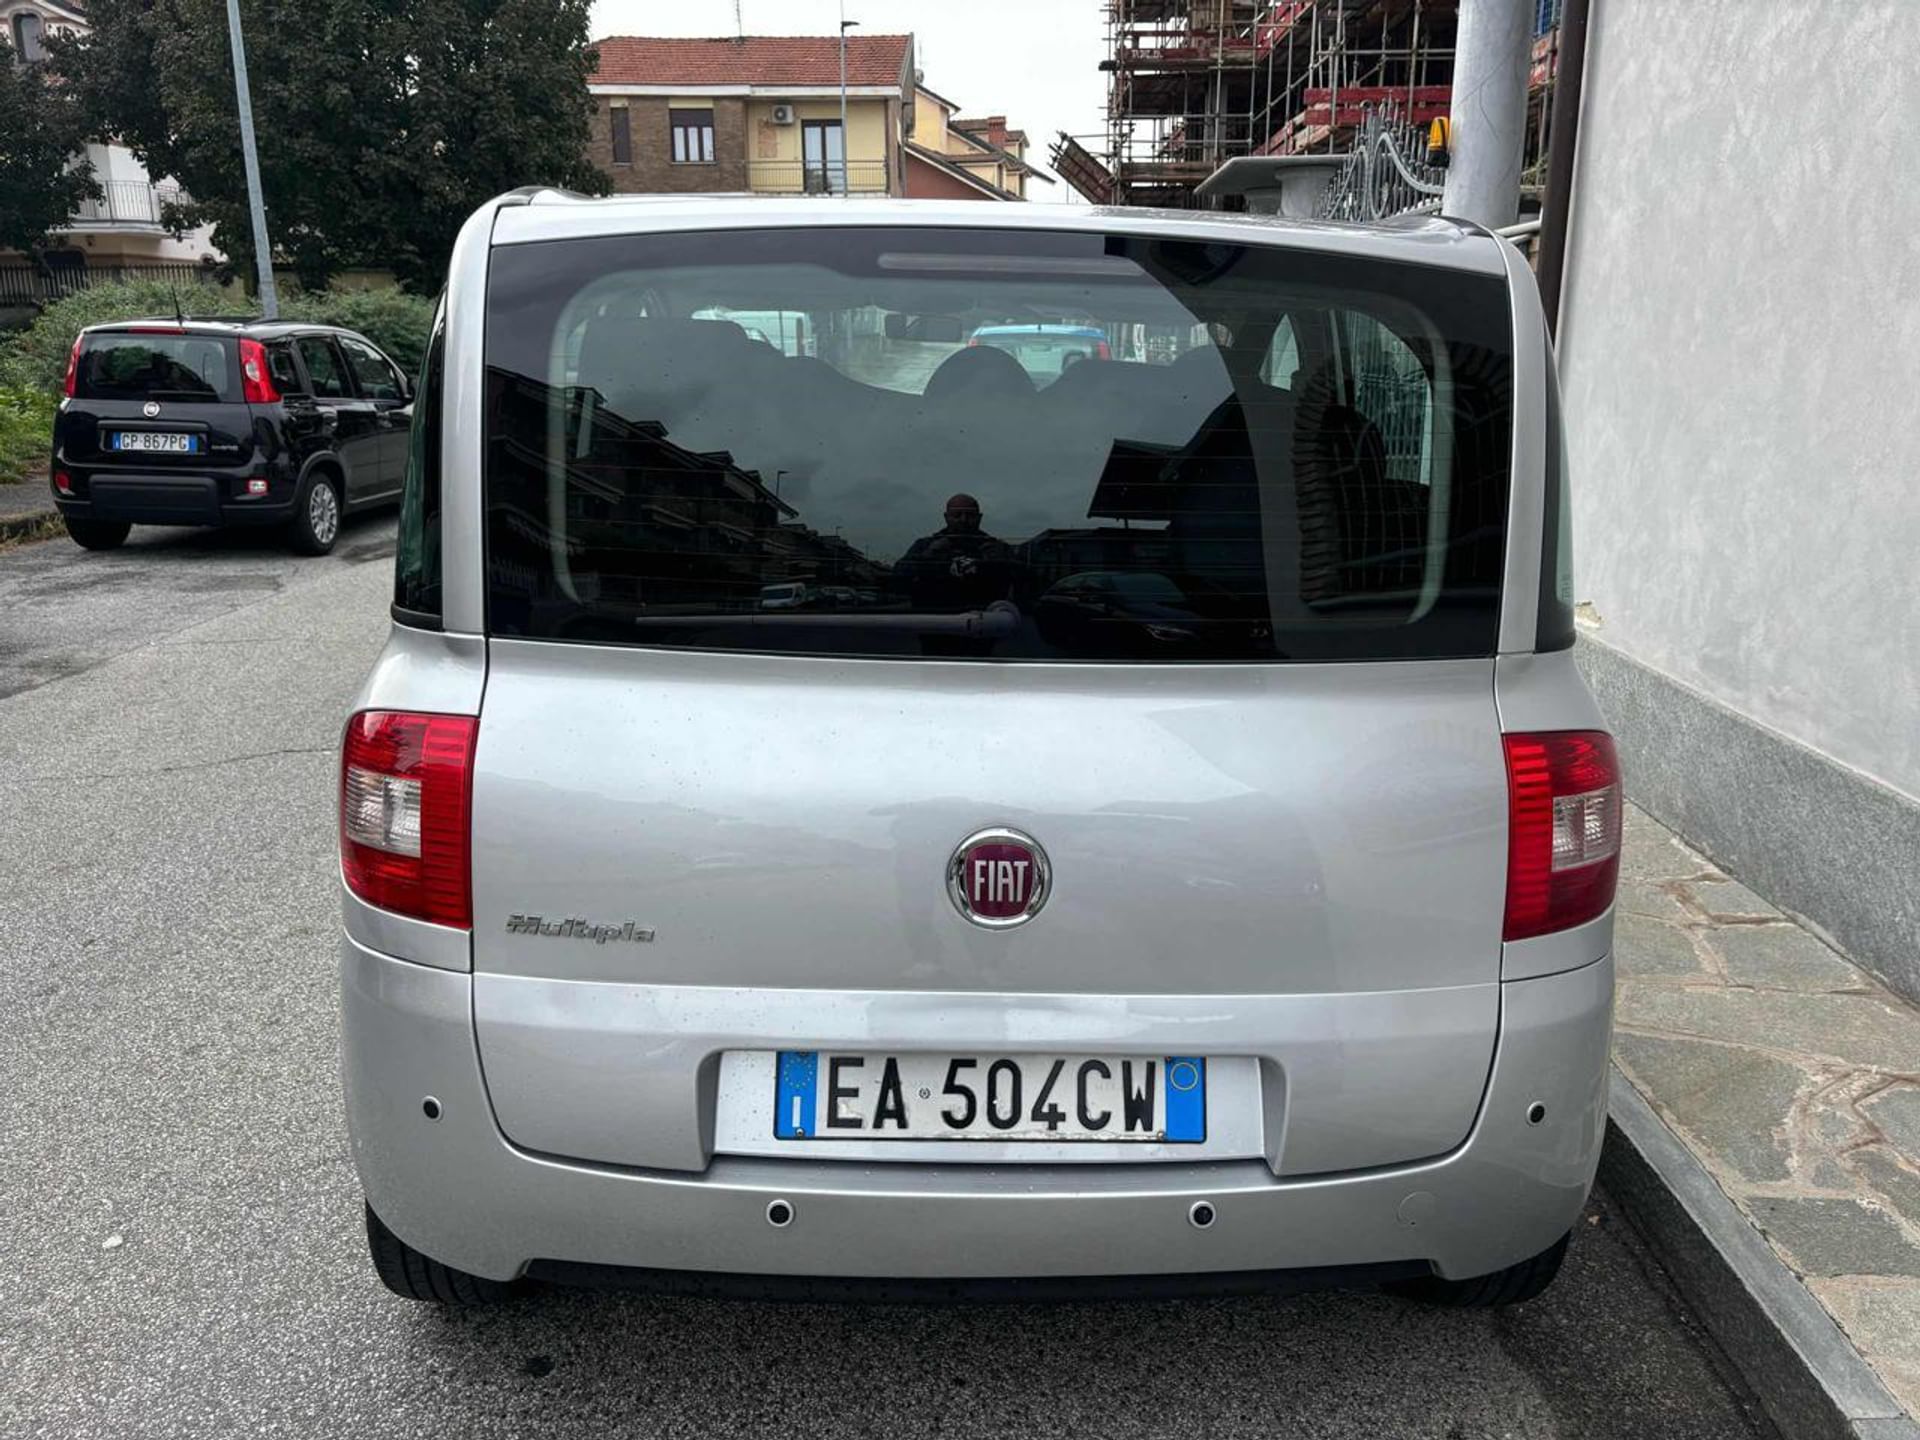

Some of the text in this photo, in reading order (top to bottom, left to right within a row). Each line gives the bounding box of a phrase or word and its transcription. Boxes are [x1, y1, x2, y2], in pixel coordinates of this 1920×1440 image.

[122, 434, 187, 450] GP 867PG
[974, 860, 1029, 902] FIAT
[505, 913, 656, 944] Multipla
[827, 1057, 1156, 1132] EA 504CW
[792, 1096, 802, 1128] I
